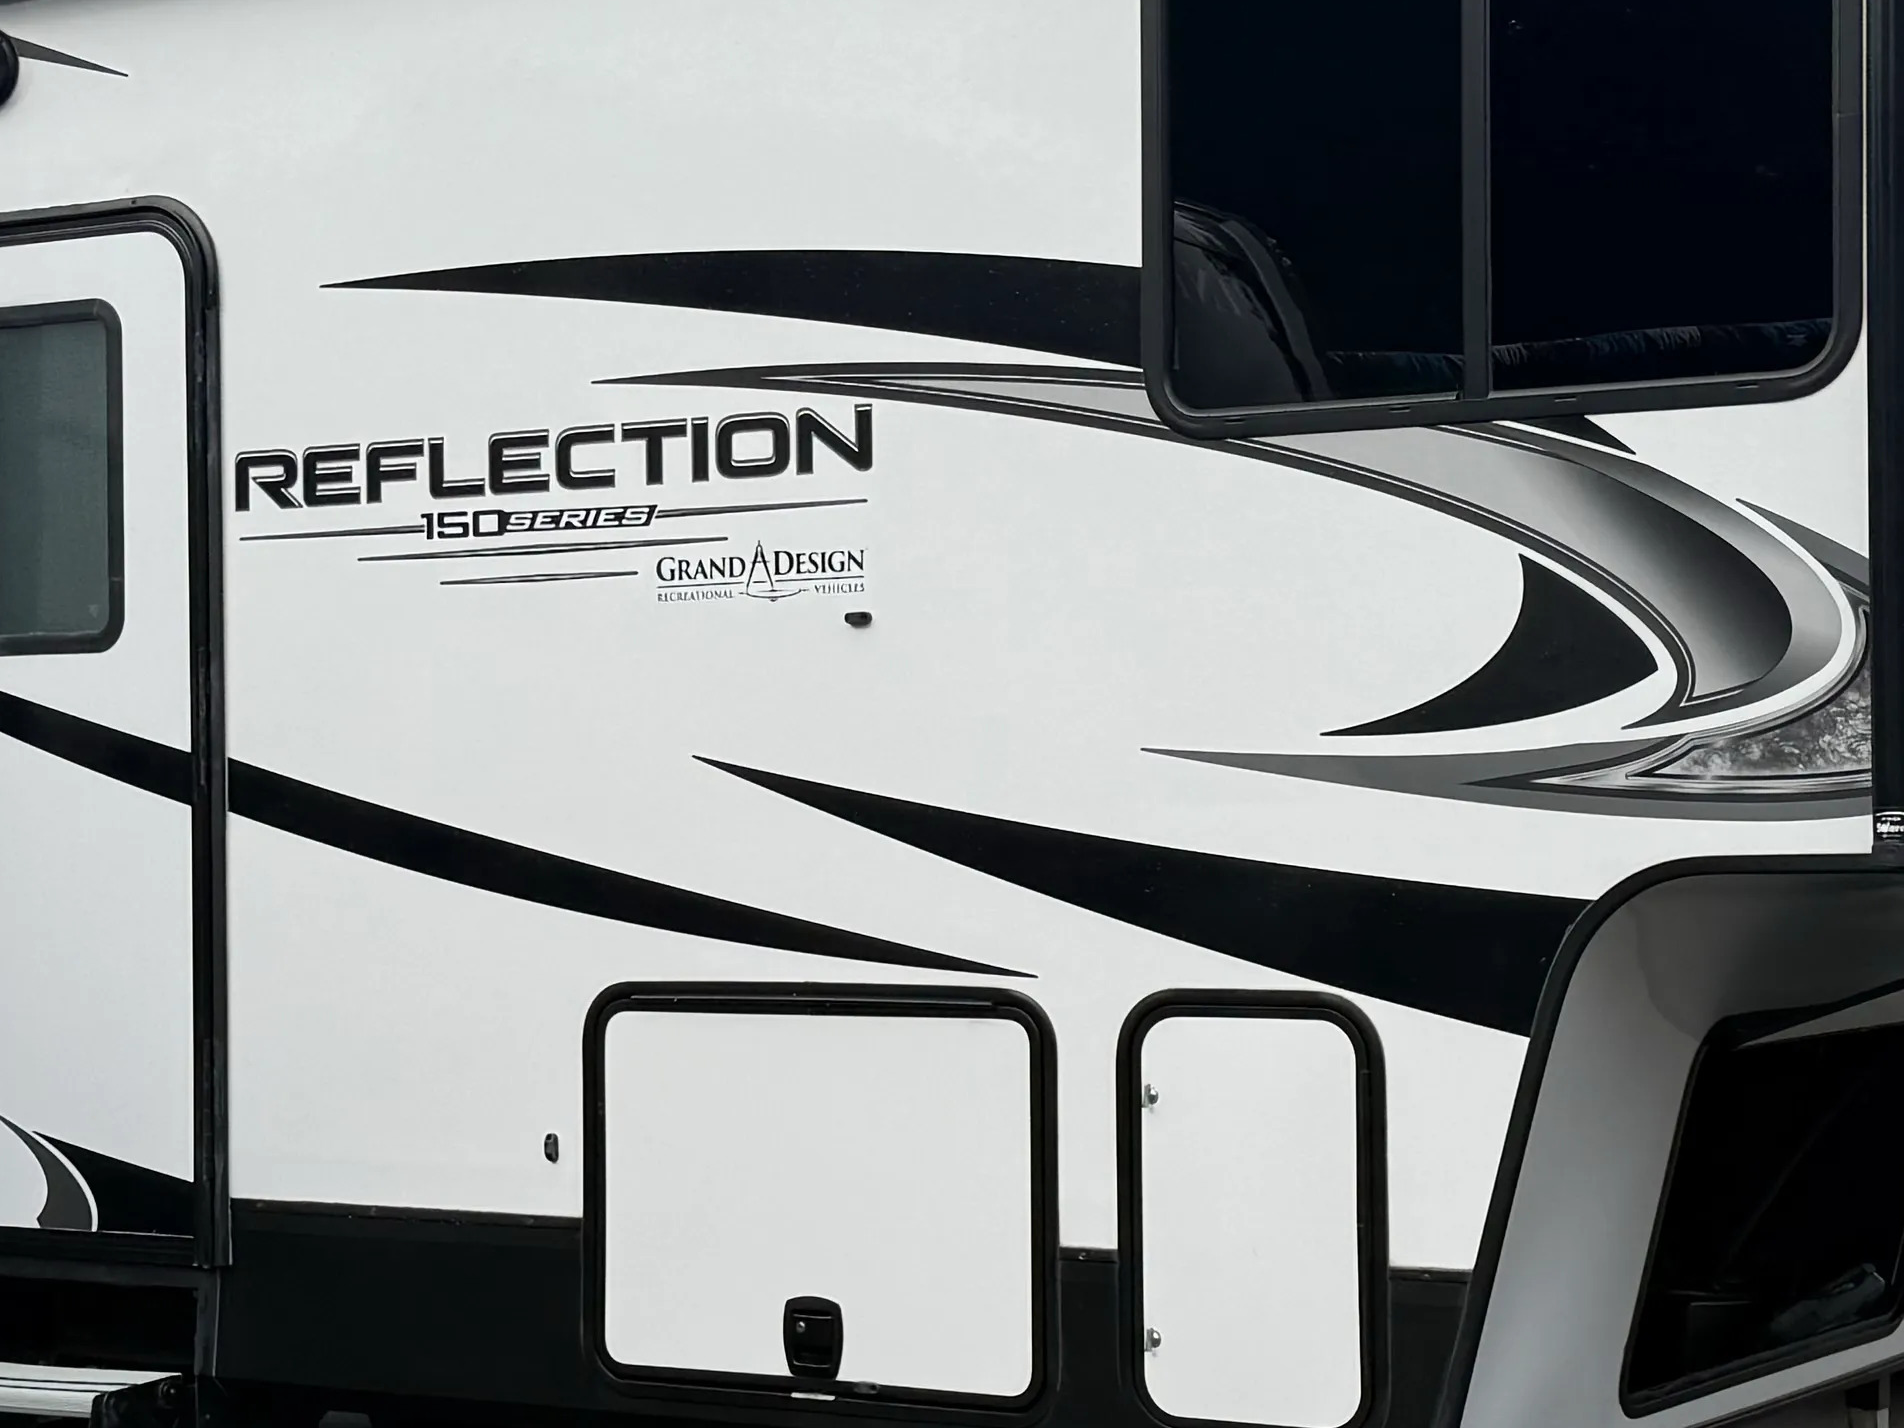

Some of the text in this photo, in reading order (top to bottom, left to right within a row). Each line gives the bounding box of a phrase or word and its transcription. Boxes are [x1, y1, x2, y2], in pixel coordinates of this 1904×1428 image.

[234, 403, 874, 512] REFLECTION
[420, 506, 652, 540] 150 SERIES
[656, 549, 866, 582] GRAND DESIGN
